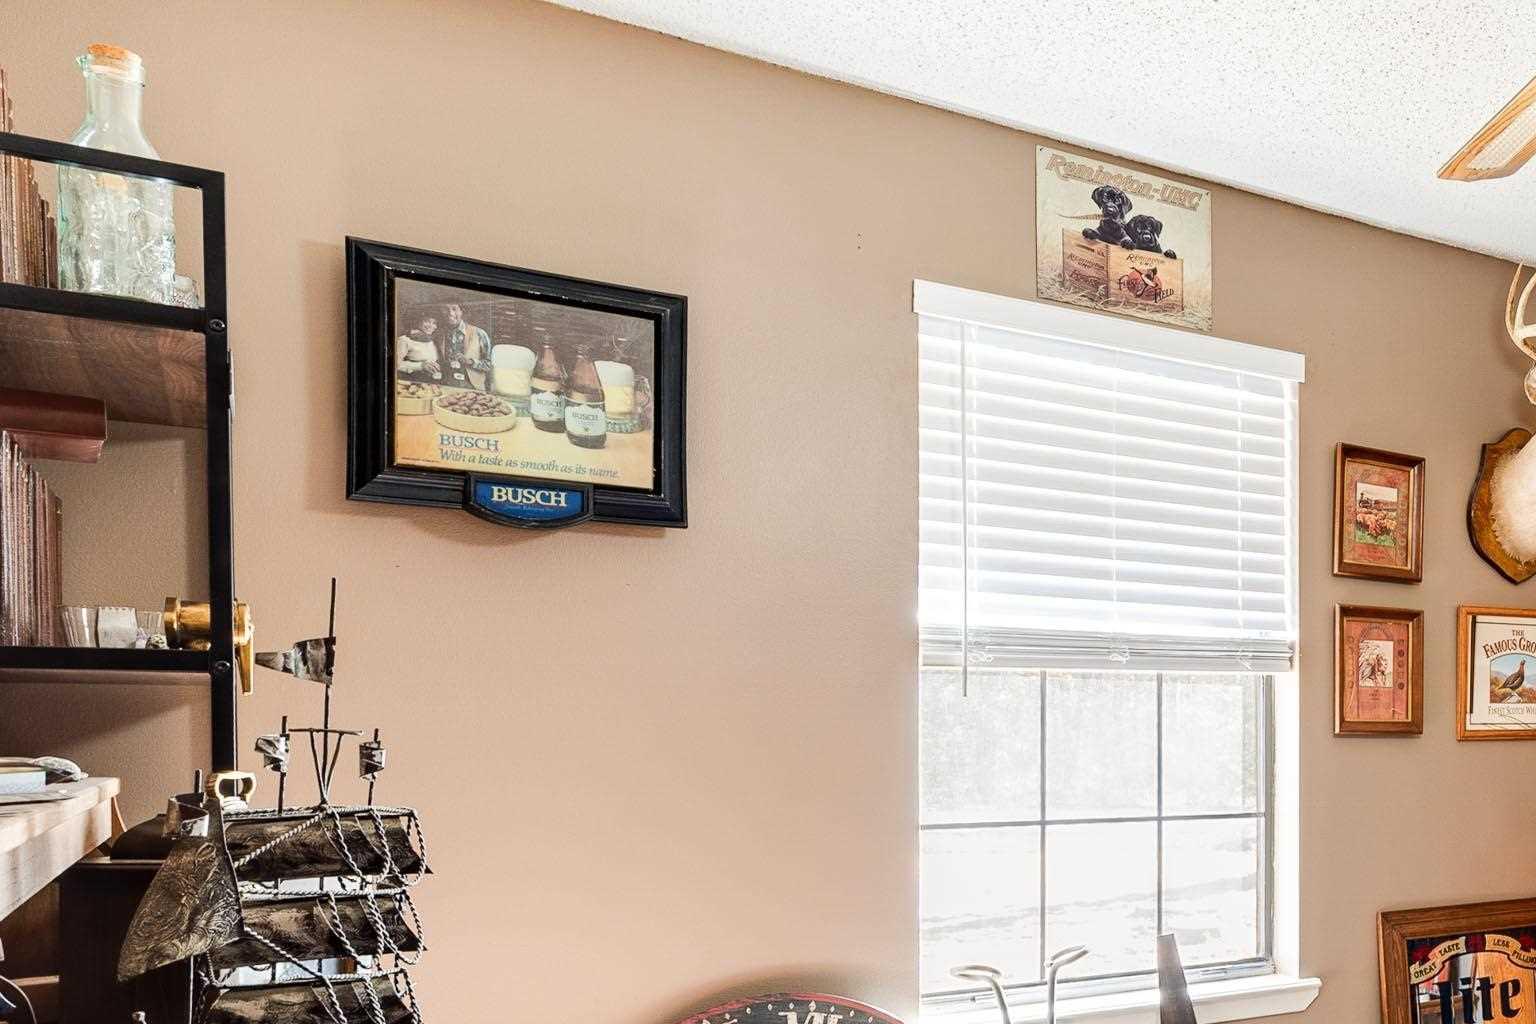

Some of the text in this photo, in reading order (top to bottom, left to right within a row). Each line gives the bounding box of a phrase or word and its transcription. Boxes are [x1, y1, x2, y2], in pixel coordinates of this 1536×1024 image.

[440, 434, 500, 451] BUSCH
[440, 448, 466, 463] With
[468, 455, 476, 463] a
[479, 453, 504, 466] taste
[505, 459, 518, 468] as
[520, 457, 559, 472] smooth
[561, 464, 573, 473] as
[575, 463, 586, 475] its
[491, 486, 568, 507] BUSCH
[1512, 629, 1525, 637] THE
[1482, 638, 1518, 659] FAMOUS
[1492, 938, 1510, 949] LESS
[1413, 942, 1461, 979] GREAT TASTE
